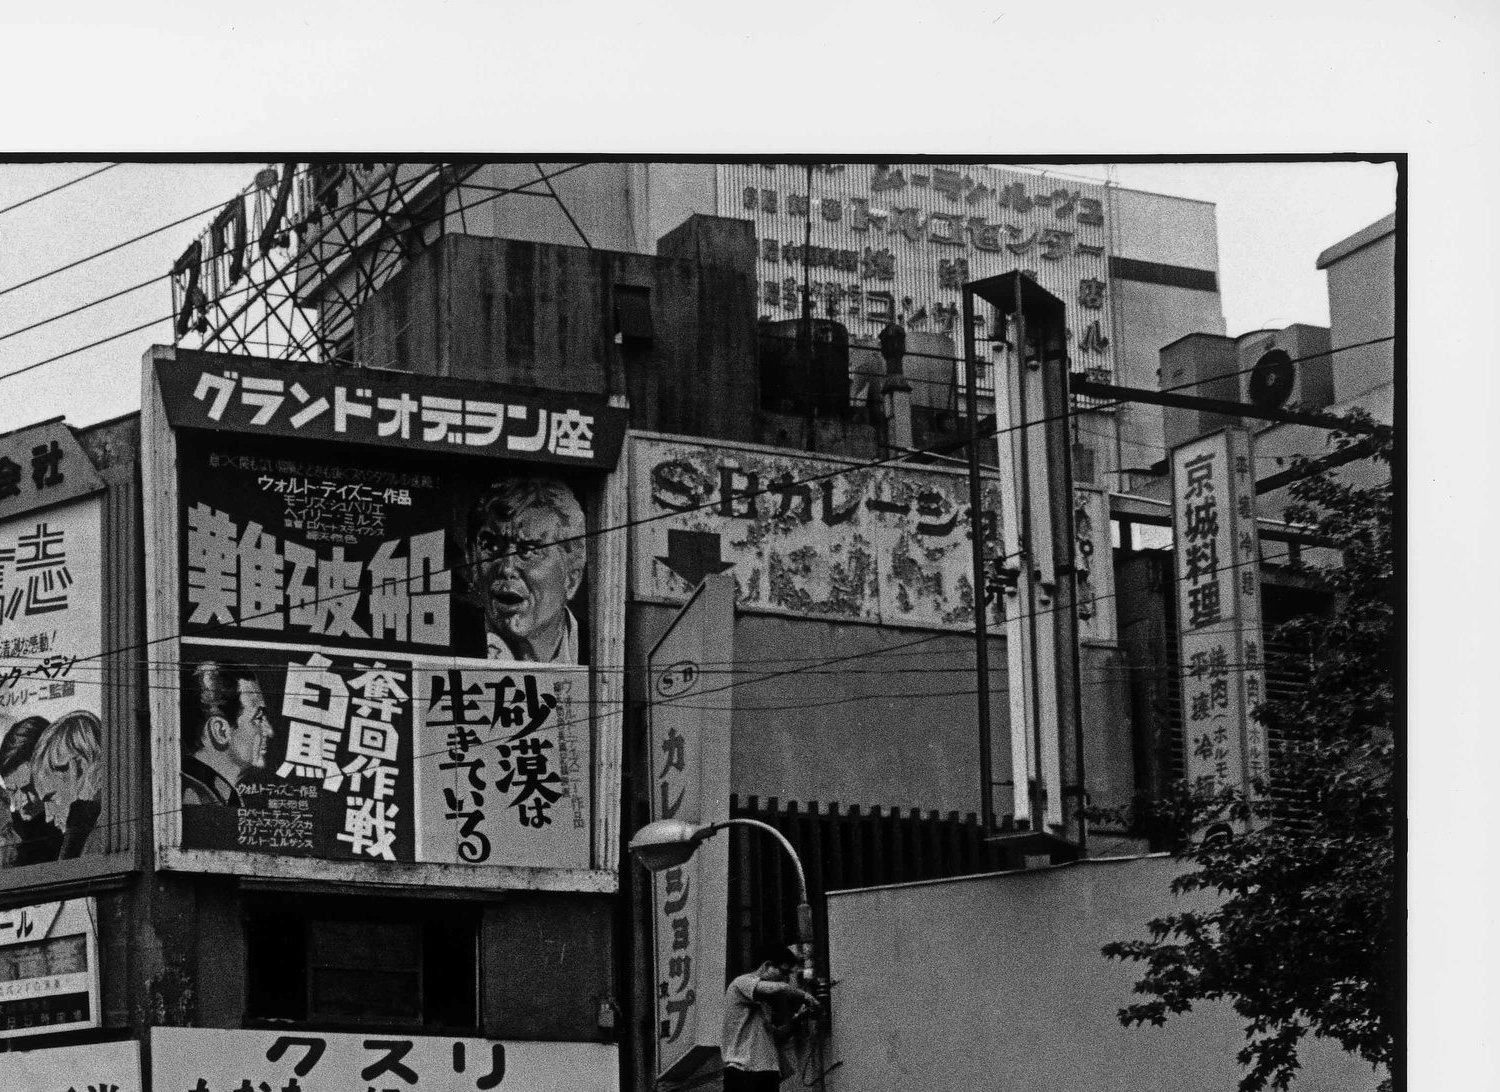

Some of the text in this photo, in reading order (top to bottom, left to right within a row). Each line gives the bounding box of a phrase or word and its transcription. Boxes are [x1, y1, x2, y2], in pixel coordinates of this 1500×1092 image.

[193, 371, 596, 459] グランドオデヲン座
[188, 501, 452, 648] 難破船
[1184, 451, 1222, 630] 京城料理
[276, 652, 349, 793] 白馬
[337, 659, 411, 862] 奪回作戦
[425, 670, 493, 863] 生きている
[485, 674, 564, 828] 砂漠は
[659, 726, 697, 1045] カレショップ
[266, 1035, 506, 1090] クスリ
